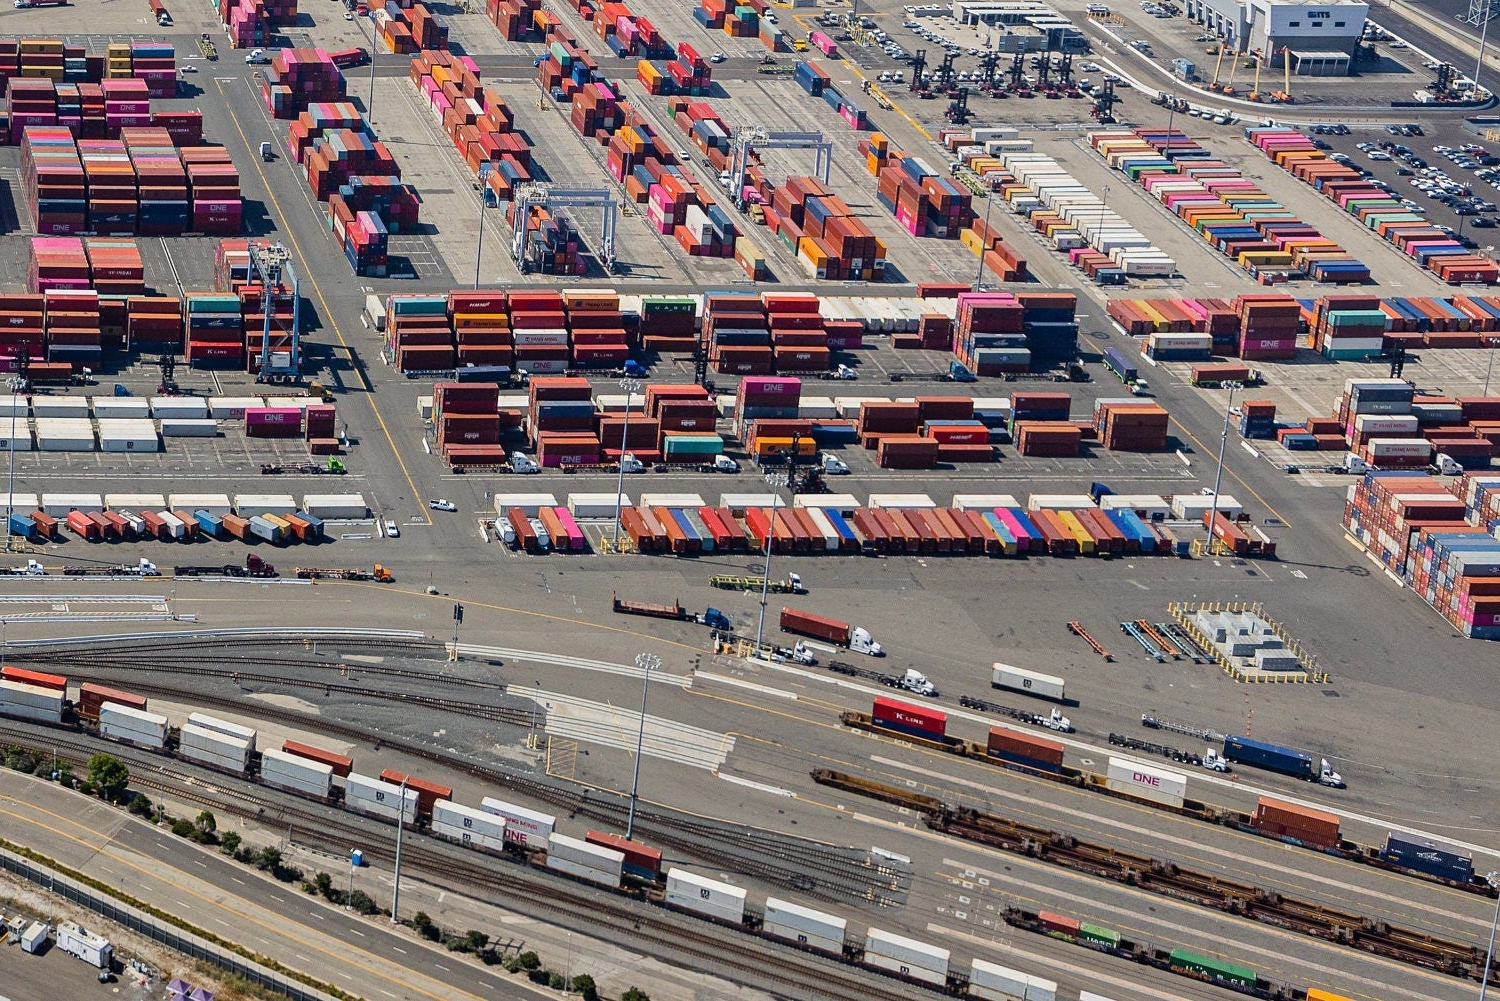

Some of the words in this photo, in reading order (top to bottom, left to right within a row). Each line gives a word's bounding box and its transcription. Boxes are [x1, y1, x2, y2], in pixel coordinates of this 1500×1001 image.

[827, 338, 846, 346] ONE
[1260, 340, 1280, 348] ONE
[561, 455, 581, 463] ONE
[905, 716, 924, 726] LINE
[1132, 772, 1161, 787] ONE
[520, 821, 538, 830] MING
